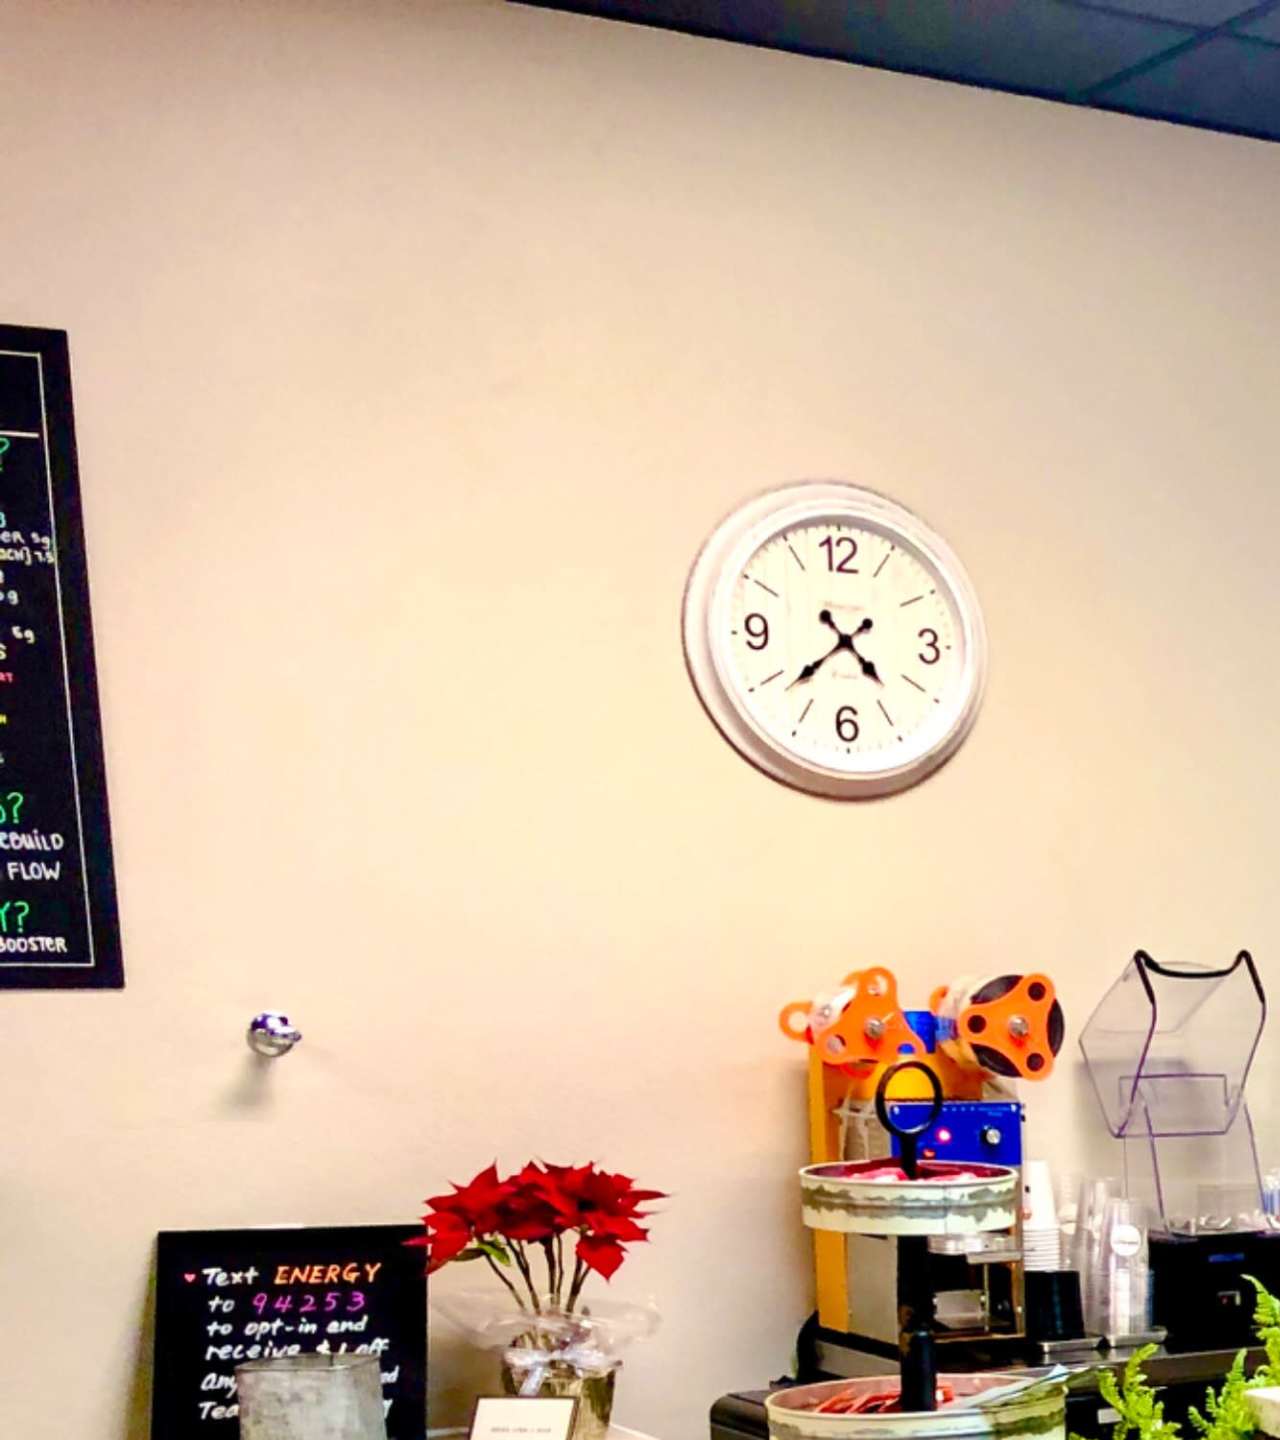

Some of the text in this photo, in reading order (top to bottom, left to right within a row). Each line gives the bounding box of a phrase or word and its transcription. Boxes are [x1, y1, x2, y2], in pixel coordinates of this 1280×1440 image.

[818, 535, 860, 574] 12
[744, 612, 769, 651] 9
[918, 628, 941, 665] 3
[835, 705, 860, 742] 6
[7, 862, 61, 880] FLOW
[201, 1262, 382, 1287] Text ENERGY
[208, 1295, 235, 1313] to
[206, 1320, 233, 1337] to
[244, 1317, 318, 1341] opt-in
[205, 1340, 301, 1360] receive
